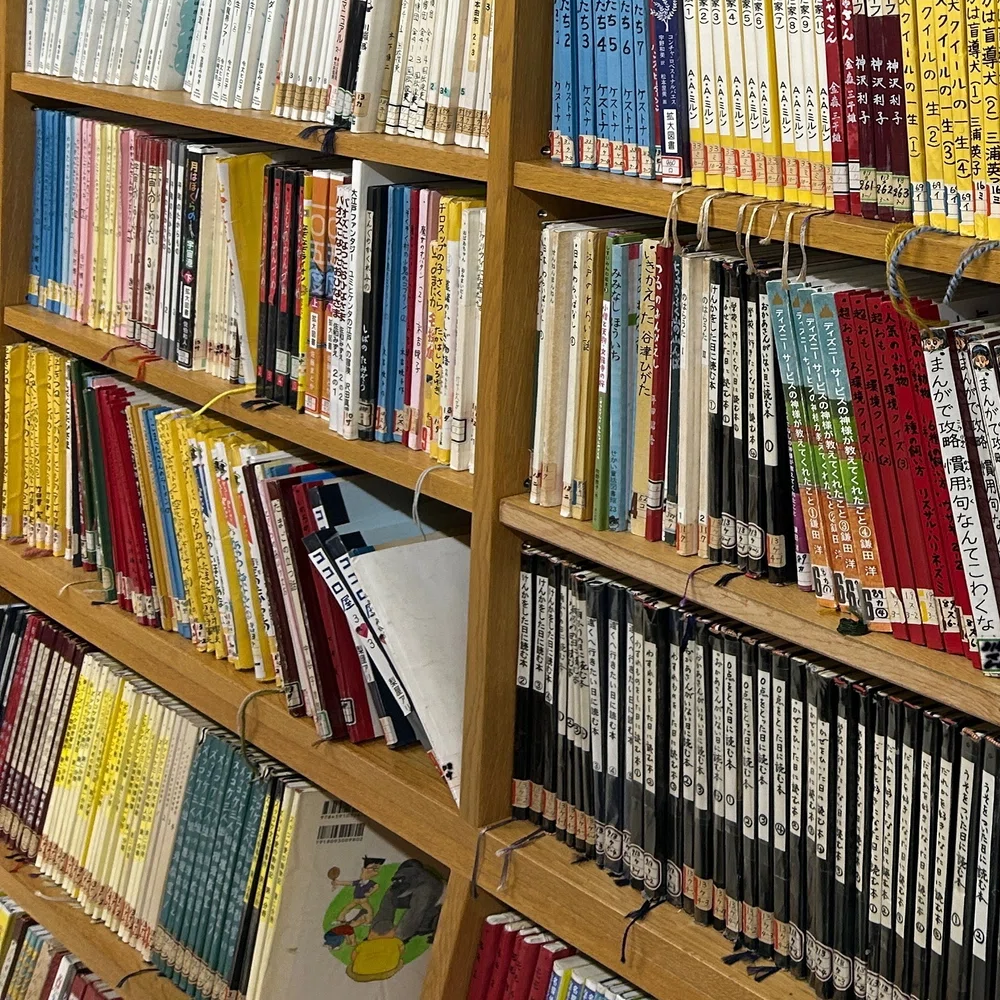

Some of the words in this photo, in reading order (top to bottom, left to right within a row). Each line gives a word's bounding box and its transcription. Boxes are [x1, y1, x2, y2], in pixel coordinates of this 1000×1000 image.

[871, 57, 889, 126] 神沢利子
[665, 111, 676, 151] 拡大図書
